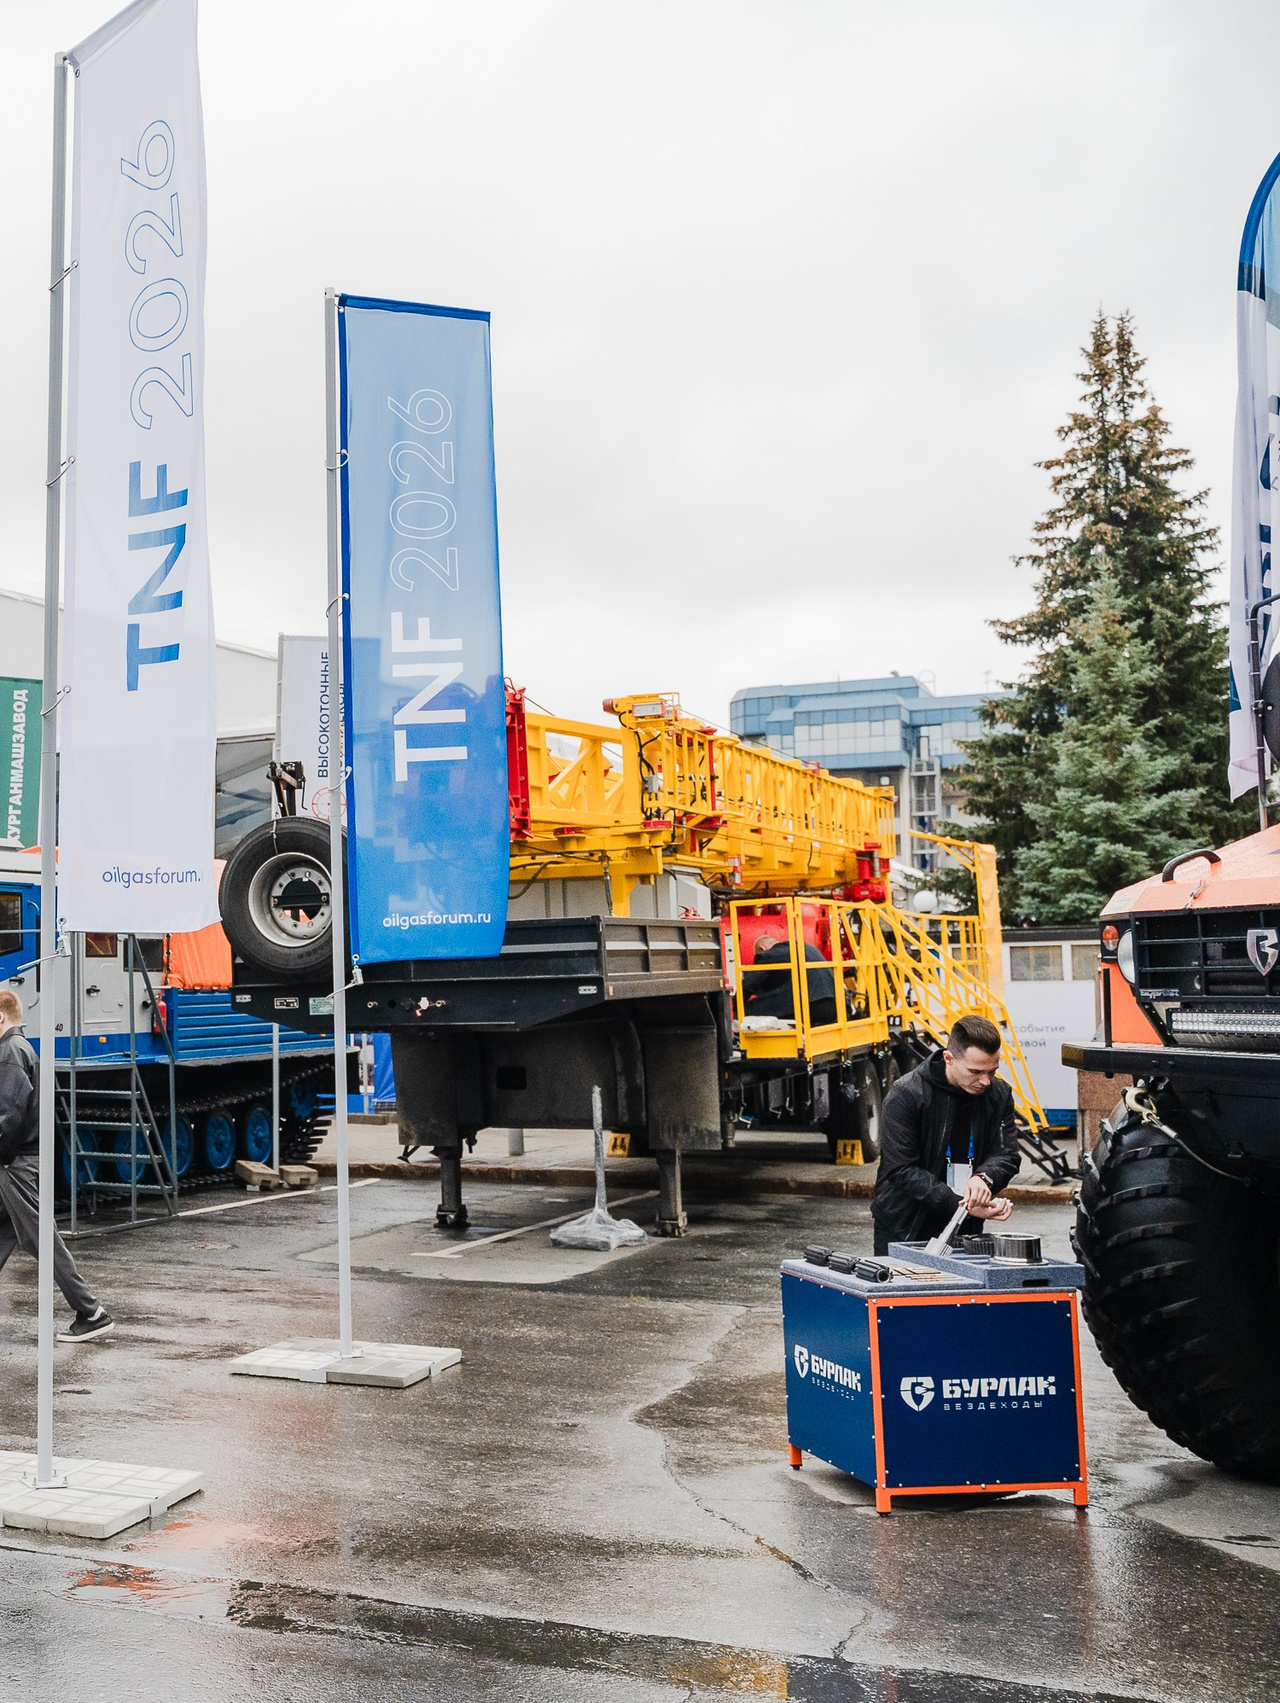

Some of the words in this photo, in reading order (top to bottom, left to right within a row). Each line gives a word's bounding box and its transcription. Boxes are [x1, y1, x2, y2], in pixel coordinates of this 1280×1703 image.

[120, 119, 194, 430] 2026
[387, 388, 460, 592] 2026
[126, 460, 189, 692] TNF
[390, 611, 468, 783] TNF
[102, 866, 202, 889] oilgasforum.
[382, 909, 492, 929] oilgasforum.ru
[811, 1353, 862, 1393] БУРЛАК
[942, 1375, 1057, 1399] БУРЛАК
[943, 1401, 1043, 1411] ВЕЗДЕХОДЫ
